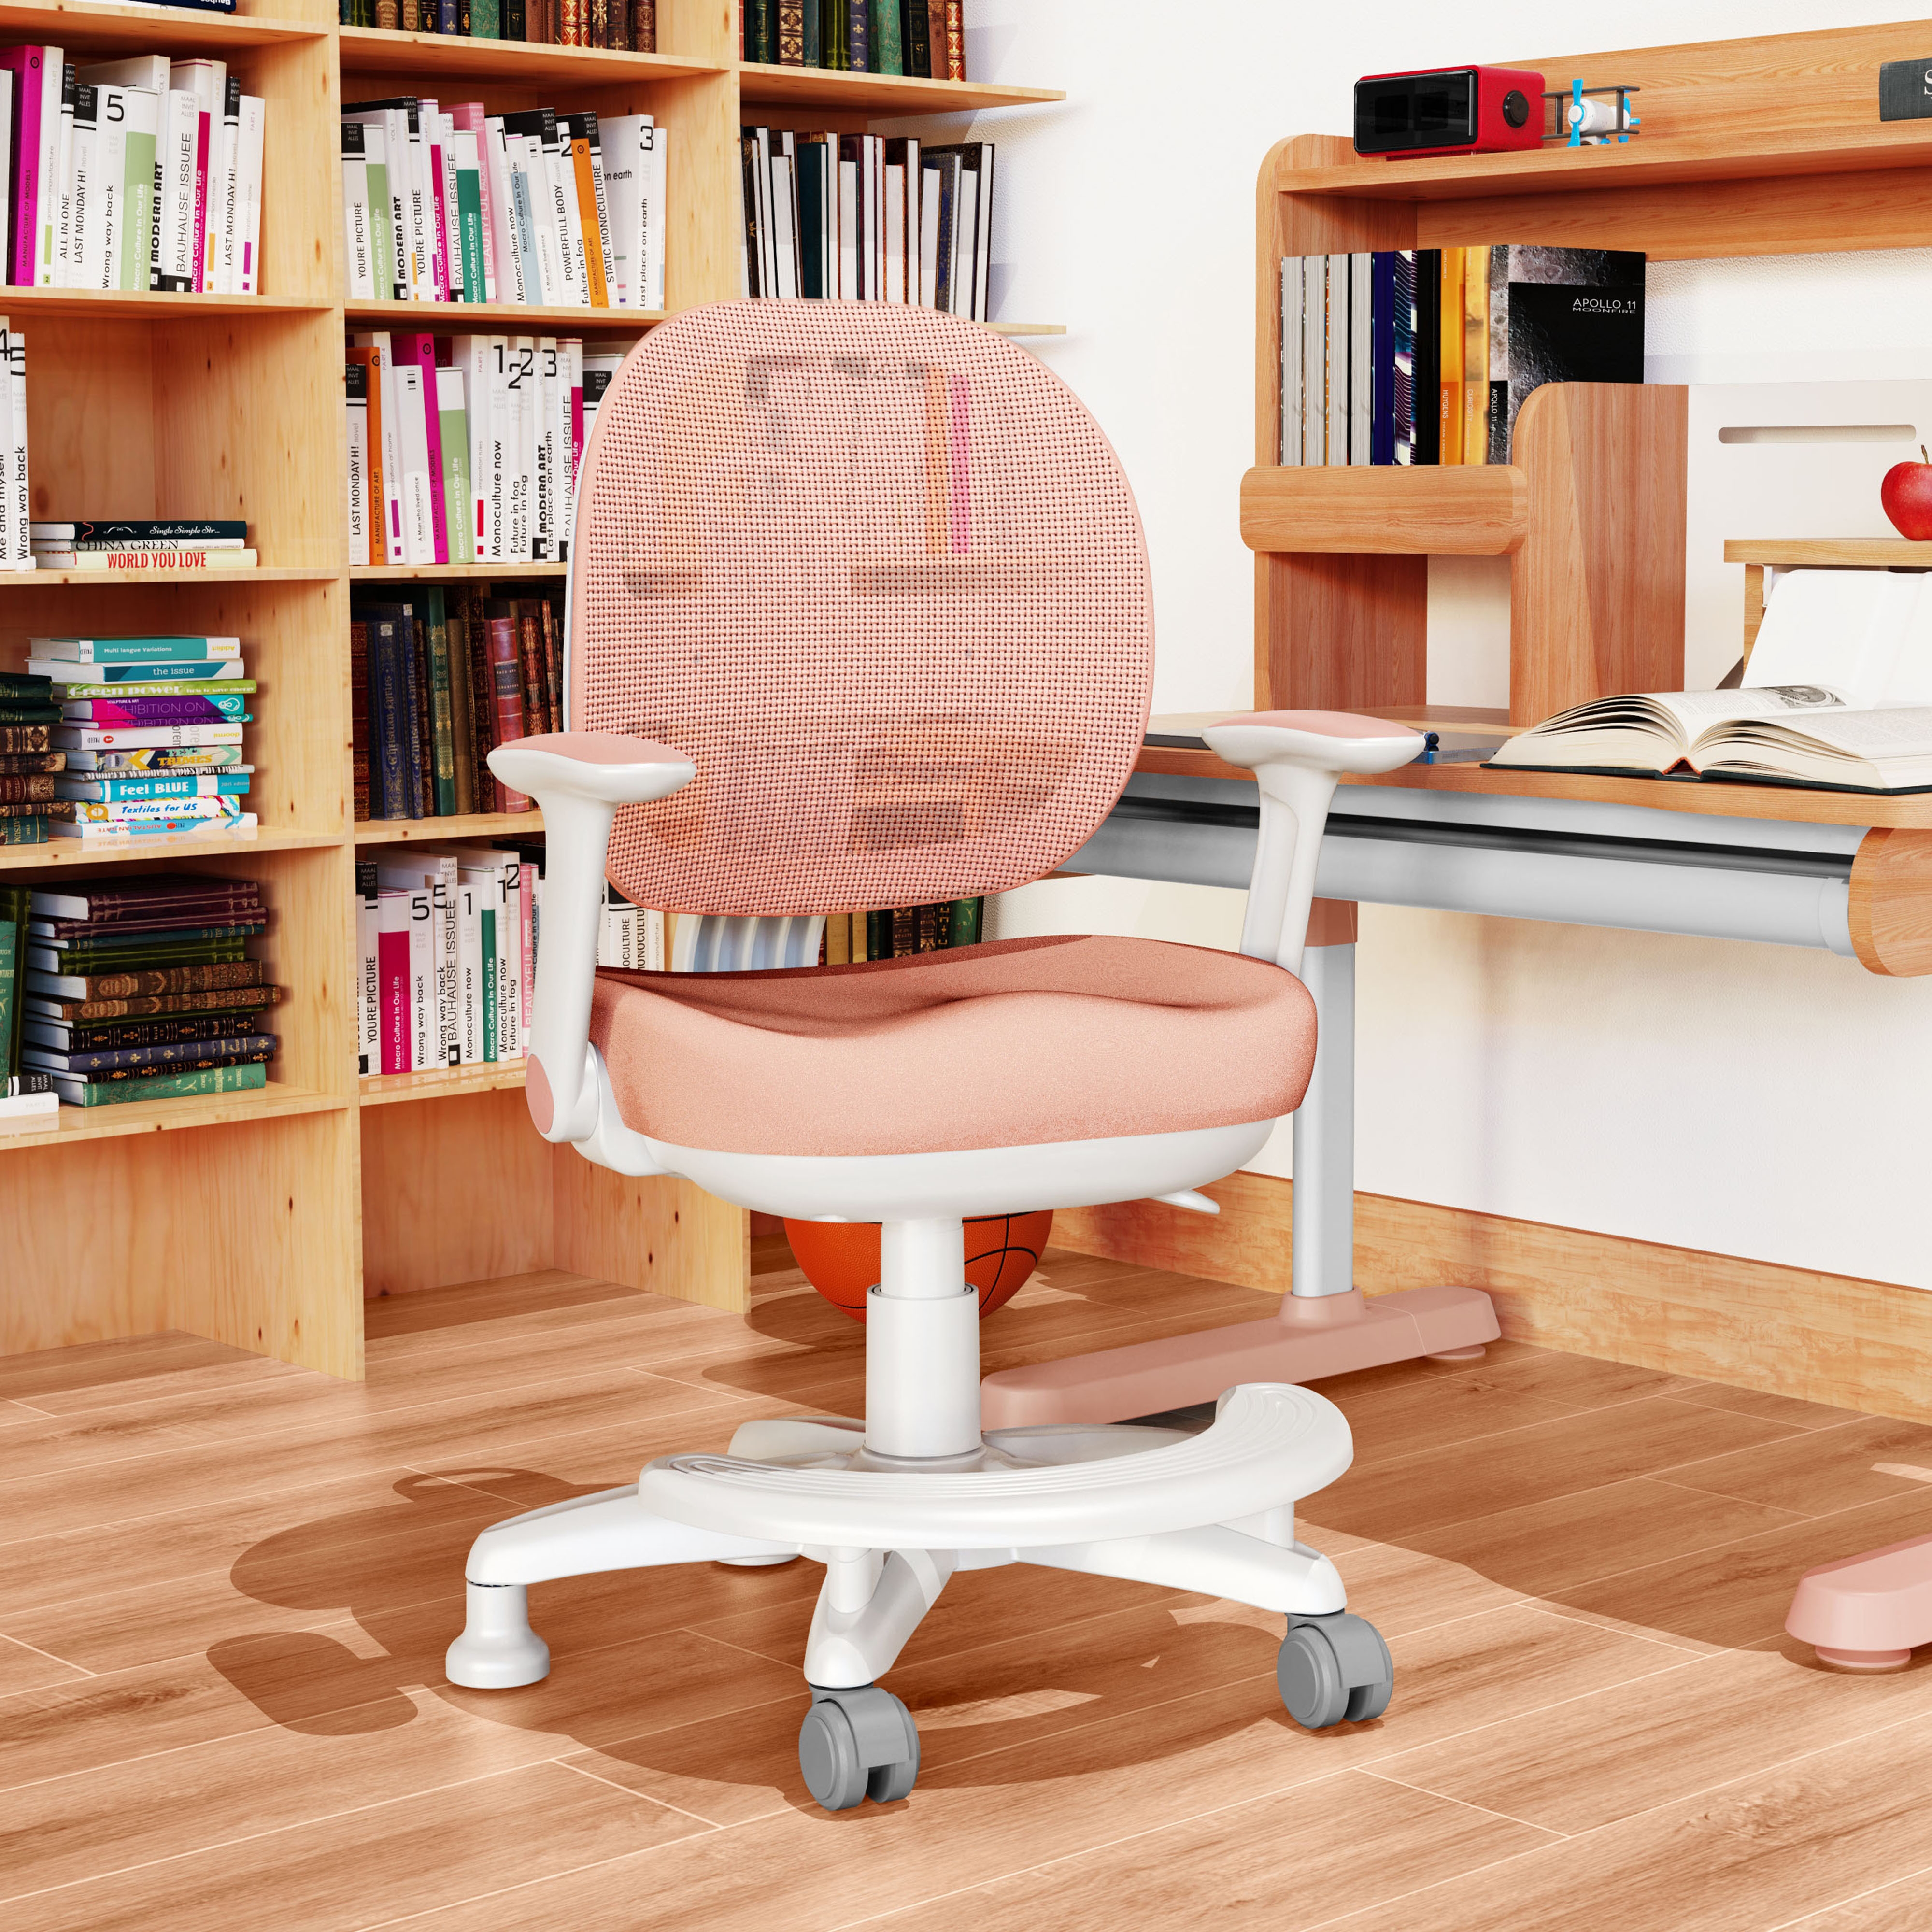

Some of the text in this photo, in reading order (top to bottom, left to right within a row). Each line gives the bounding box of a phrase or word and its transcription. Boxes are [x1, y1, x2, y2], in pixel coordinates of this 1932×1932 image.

[107, 94, 125, 122] 5
[497, 128, 507, 152] 1
[559, 133, 573, 157] 2
[640, 126, 653, 151] 3
[77, 170, 86, 183] H!
[228, 168, 236, 182] H!
[613, 169, 632, 180] earth
[25, 202, 29, 212] OF
[176, 132, 192, 272] BAUHAUSE ISSUEE
[516, 191, 523, 199] In
[75, 185, 85, 234] MONDAY
[151, 162, 163, 263] MODERN ART
[226, 184, 235, 235] MONDAY
[60, 193, 70, 259] ALL IN ONE
[412, 189, 426, 275] YOURE PICTURE
[480, 193, 493, 275] BEAUTYFUL
[554, 185, 574, 281] POWERFULL BODY
[592, 164, 614, 283] STATIC MONOCULTURE
[74, 236, 84, 263] LAST
[102, 185, 114, 289] Wrong way back
[354, 201, 367, 279] YOURE PICTURE
[393, 196, 406, 279] MODERN ART
[520, 228, 528, 252] Macro
[641, 231, 647, 245] on
[508, 207, 525, 301] Monoculture now
[590, 255, 599, 295] MANUFACTURE
[1572, 298, 1636, 310] APOLLO 11
[493, 344, 503, 373] 1
[351, 446, 359, 457] H!
[351, 460, 360, 507] MONDAY
[374, 483, 380, 494] OF
[432, 479, 437, 488] OF
[520, 475, 528, 496] fog
[547, 468, 553, 483] on
[491, 440, 502, 556] Monoculture now
[538, 445, 547, 533] MODERN ART
[14, 446, 29, 560] Wrong way back
[432, 490, 440, 540] MANUFACTURE
[520, 501, 527, 511] in
[352, 510, 361, 536] LAST
[511, 481, 520, 553] Future in fog
[149, 526, 173, 535] Single
[174, 526, 201, 536] Simple
[76, 540, 179, 551] CHINA GREEN
[107, 552, 207, 568] WORLD YOU LOVE
[69, 687, 122, 696] Green
[128, 685, 183, 696] power
[107, 702, 205, 715] EXHIBITION ON
[120, 781, 189, 796] Feel BLUE
[121, 805, 160, 814] Textiles
[183, 803, 198, 811] US
[464, 892, 471, 915] 1
[497, 879, 506, 903] 1
[412, 896, 430, 921] 5
[622, 917, 630, 969] OCULTURE
[437, 966, 446, 995] back
[445, 899, 457, 1041] BAUHAUSE ISSUEE
[366, 956, 377, 1044] YOURE PICTURE
[509, 979, 517, 999] fog
[394, 1005, 400, 1014] In
[498, 984, 508, 1053] Monoculture
[509, 1003, 515, 1012] in
[465, 993, 473, 1058] Monoculture
[417, 1031, 426, 1065] Wrong
[438, 1025, 447, 1061] Wrong
